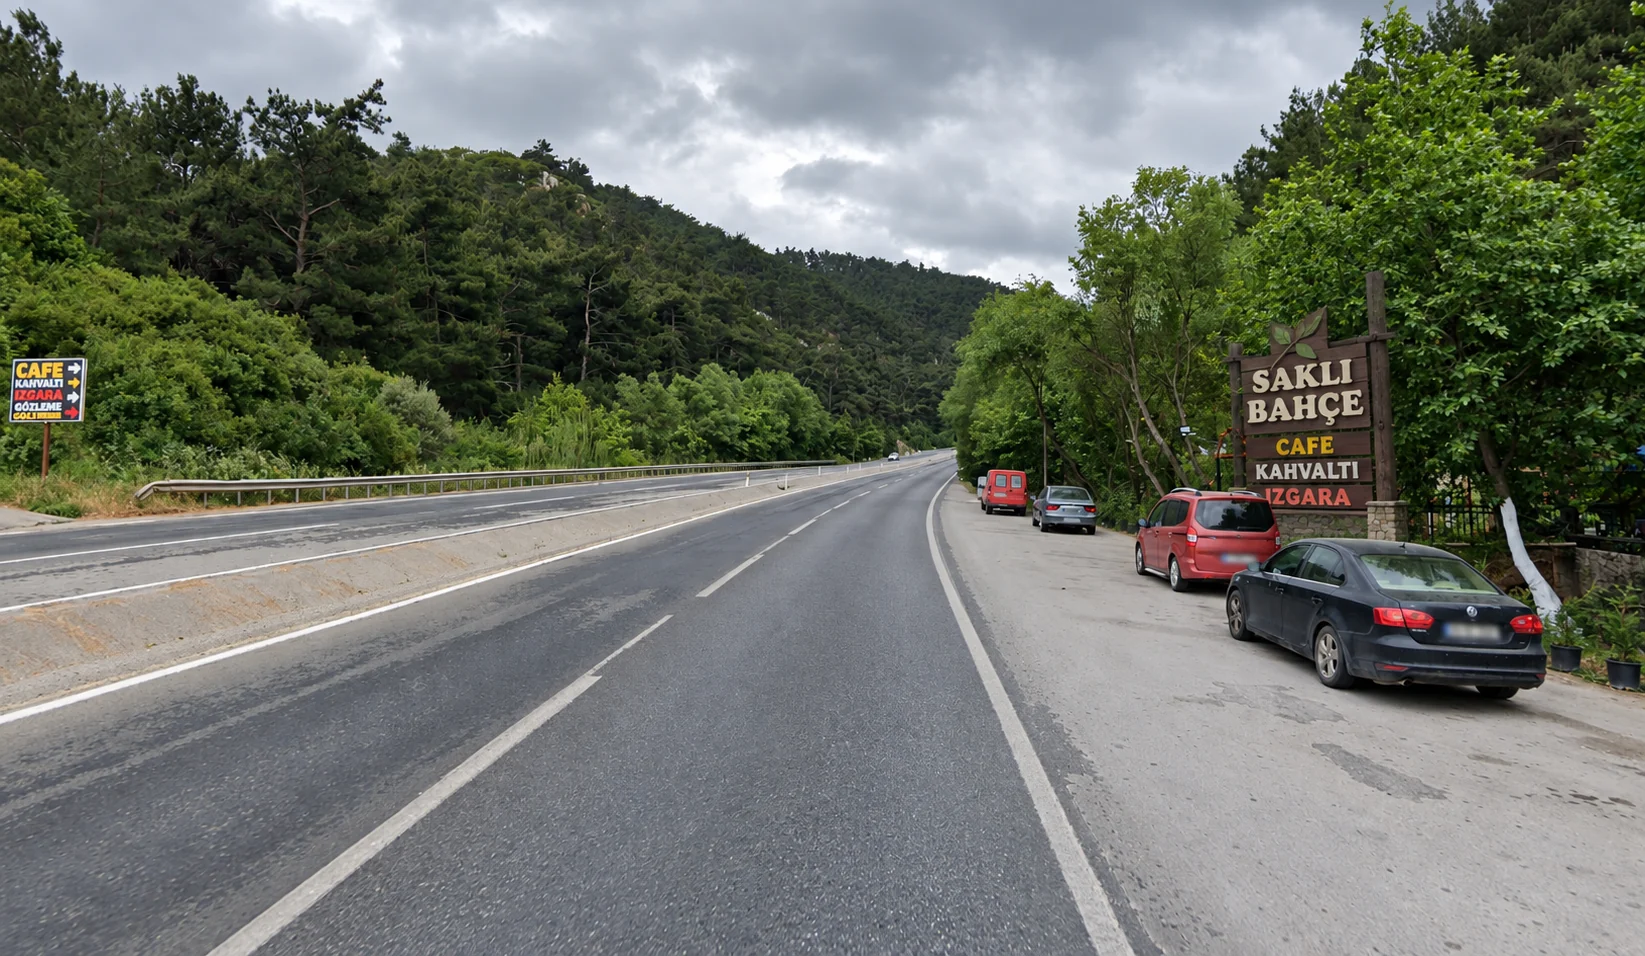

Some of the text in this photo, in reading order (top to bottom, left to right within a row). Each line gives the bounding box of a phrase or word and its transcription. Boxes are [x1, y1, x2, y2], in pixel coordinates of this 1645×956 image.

[16, 362, 64, 379] CAFE
[1252, 359, 1353, 394] SAKLI
[14, 379, 64, 388] KAHVALTI
[14, 389, 63, 401] IZGARA
[1247, 389, 1364, 426] BAHÇE
[1275, 436, 1334, 456] CAFE
[1255, 461, 1359, 480] KAHVALTI
[1265, 488, 1352, 506] IZGARA
